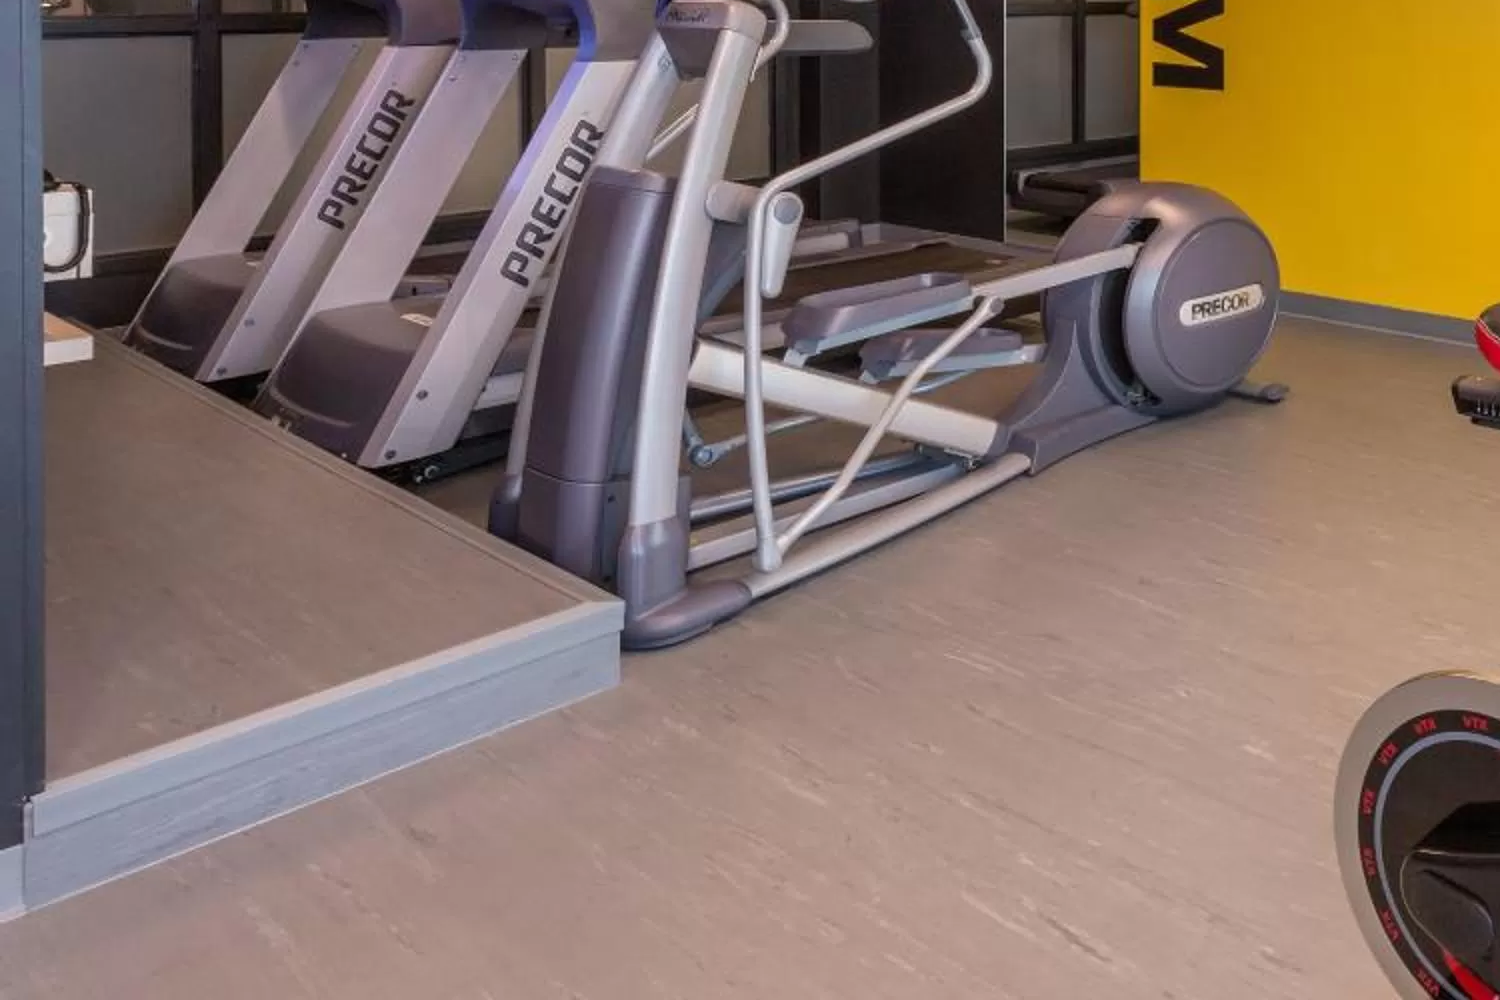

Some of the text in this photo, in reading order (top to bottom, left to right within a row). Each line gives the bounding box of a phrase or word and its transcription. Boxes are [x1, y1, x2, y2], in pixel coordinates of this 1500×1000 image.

[317, 89, 415, 230] PRECOR
[500, 119, 605, 288] PRECOR
[1191, 291, 1249, 321] PRECOR
